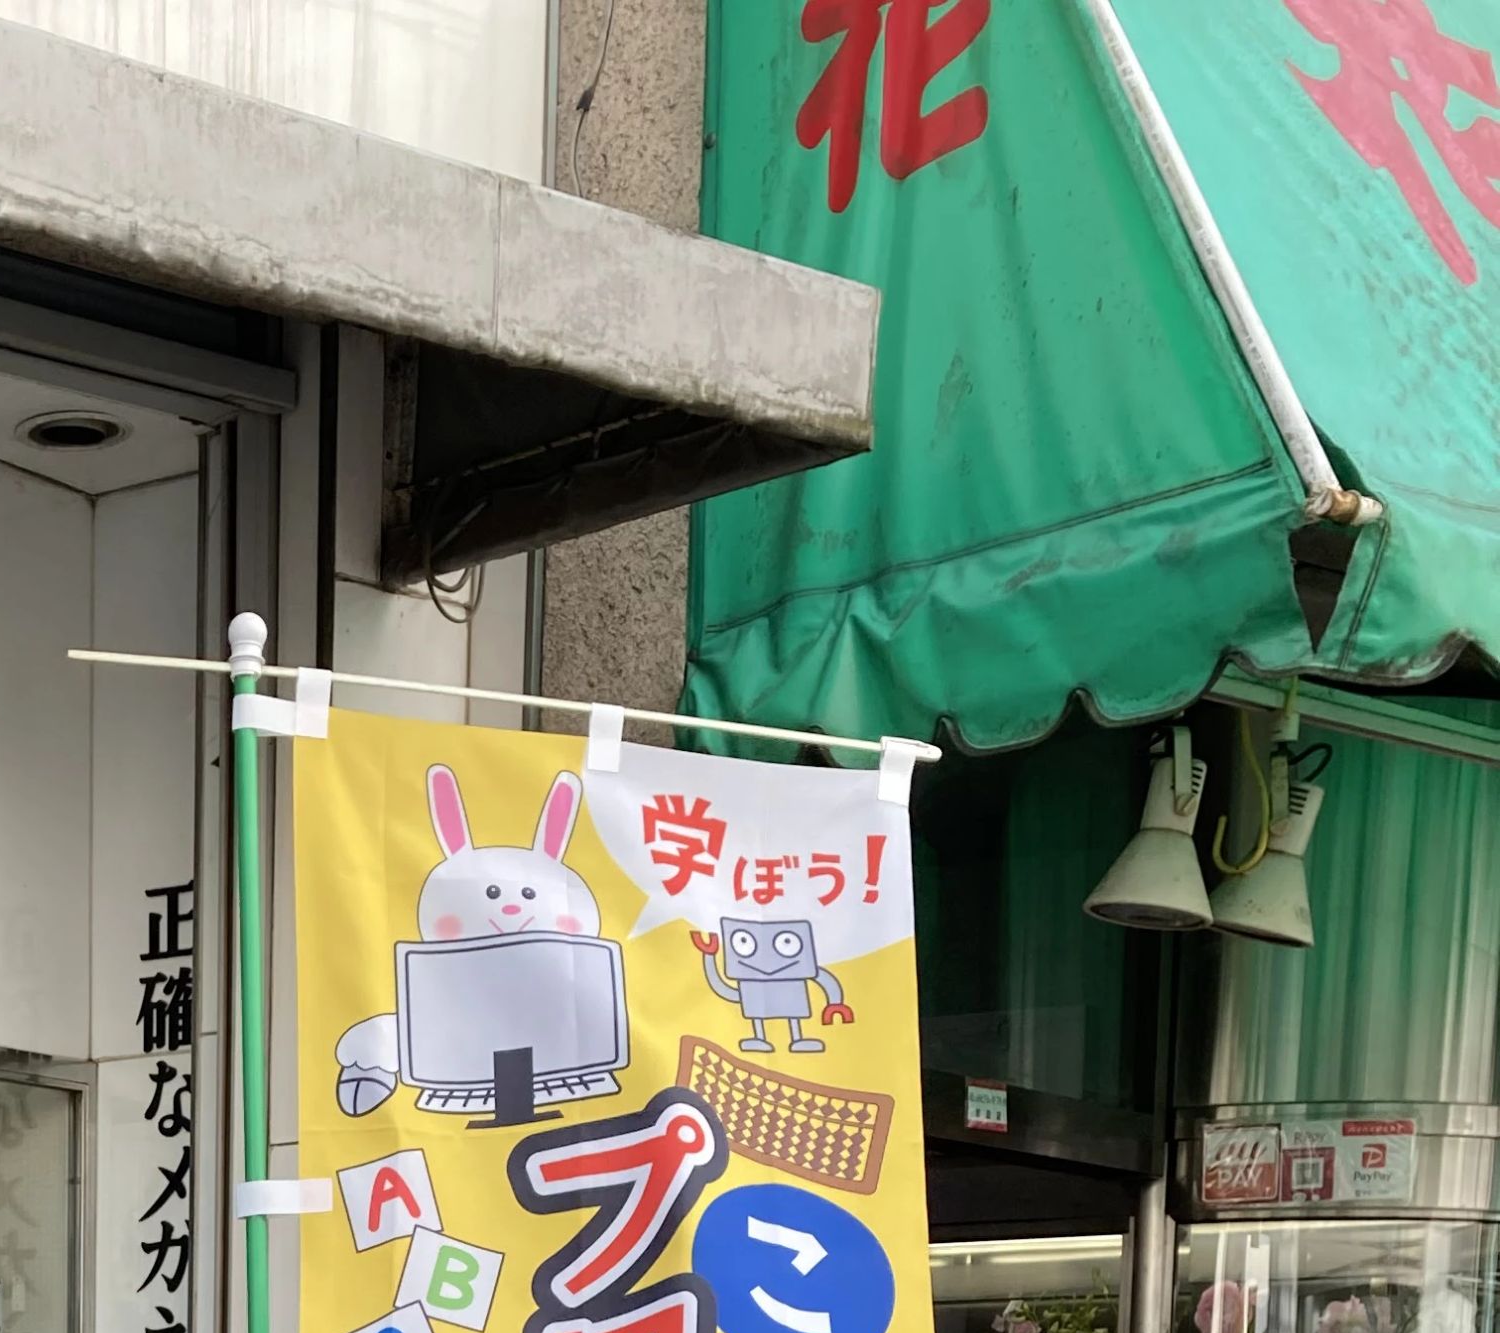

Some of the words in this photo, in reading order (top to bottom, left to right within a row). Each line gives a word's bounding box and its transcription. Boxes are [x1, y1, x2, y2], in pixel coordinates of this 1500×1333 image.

[641, 794, 887, 906] 学ぼう！
[368, 1166, 420, 1232] A
[426, 1246, 480, 1312] B
